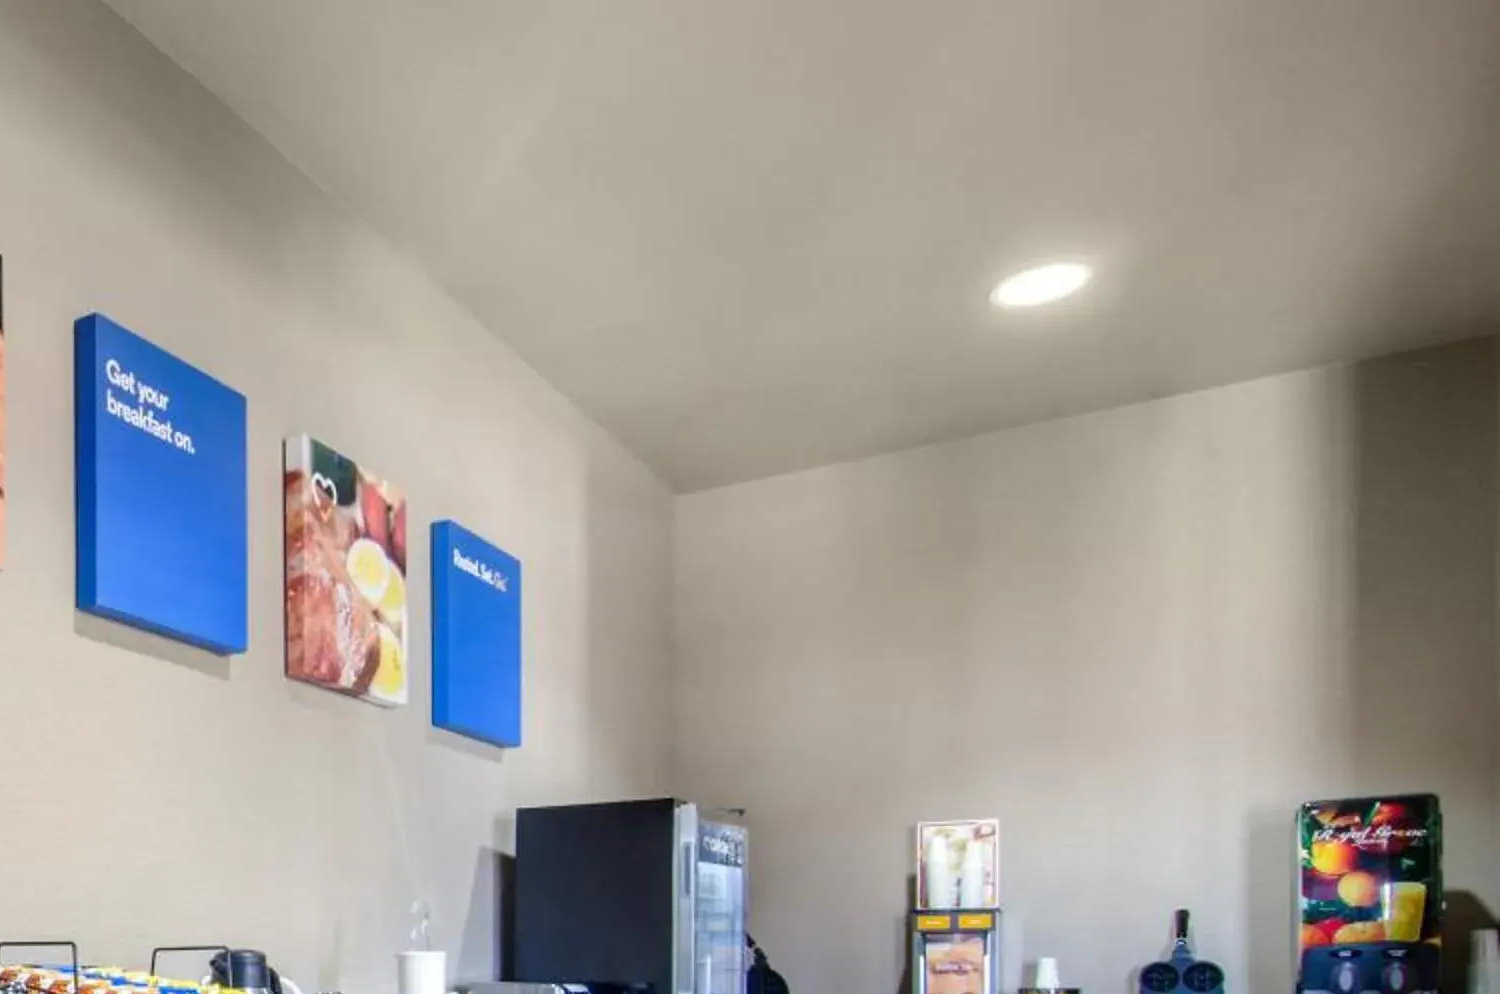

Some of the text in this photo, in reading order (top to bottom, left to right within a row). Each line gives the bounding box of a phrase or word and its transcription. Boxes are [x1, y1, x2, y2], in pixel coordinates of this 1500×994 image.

[106, 358, 169, 412] Get your
[106, 388, 197, 455] breakfast on.
